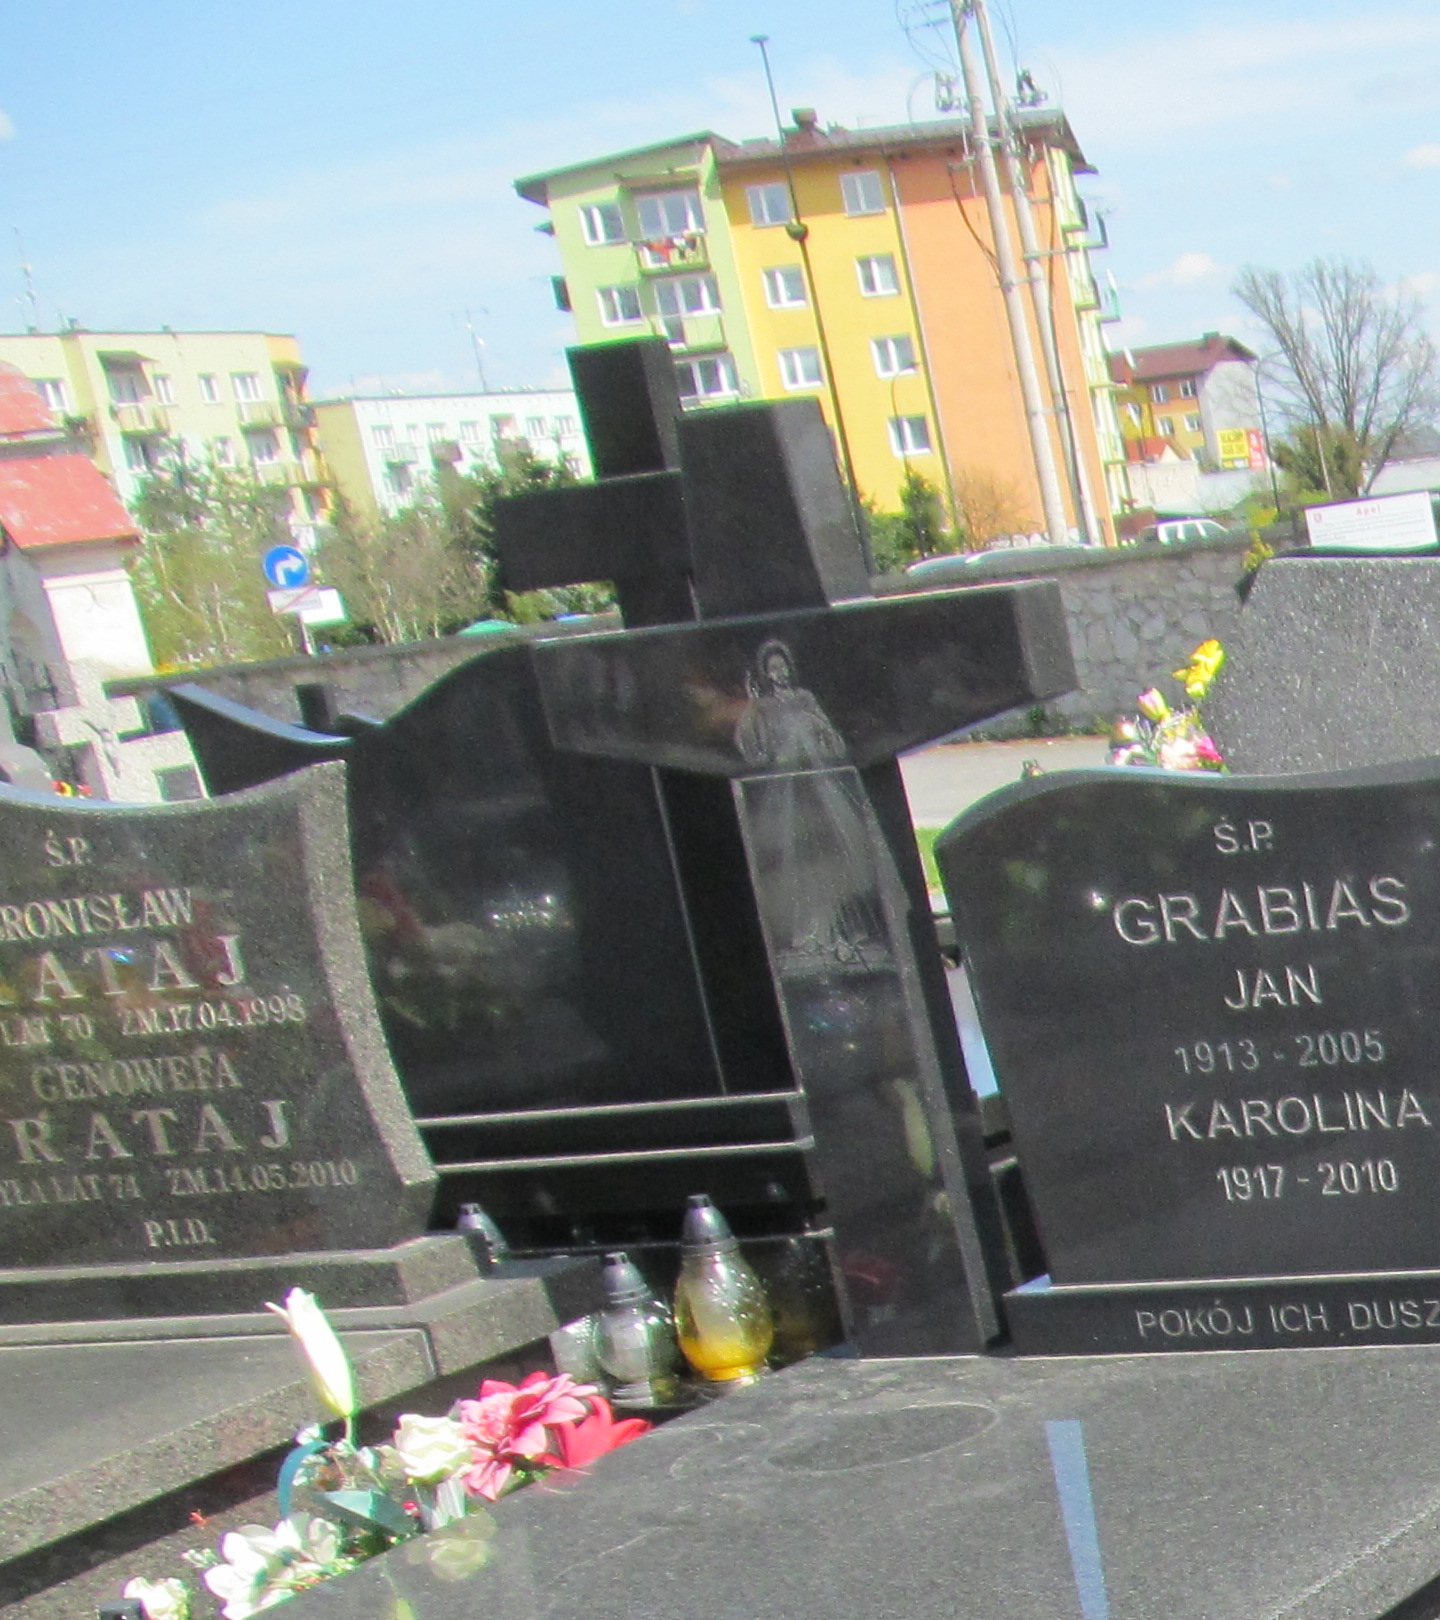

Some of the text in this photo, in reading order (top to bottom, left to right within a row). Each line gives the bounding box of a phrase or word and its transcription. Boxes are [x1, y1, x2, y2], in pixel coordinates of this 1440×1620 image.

[1356, 504, 1382, 517] Apel
[0, 887, 196, 942] RONISŁAW
[1113, 875, 1411, 946] GRABIAS
[0, 935, 245, 1004] ATAJ
[1223, 963, 1323, 1010] JAN
[1173, 1037, 1260, 1074] 1913
[1294, 1028, 1386, 1067] 2005
[31, 1052, 244, 1102] GENOWEFA
[6, 1098, 292, 1164] RATAJ
[1163, 1087, 1433, 1141] KAROLINA
[1215, 1162, 1286, 1202] 1917
[1316, 1157, 1399, 1196] 2010
[1134, 1299, 1254, 1338] POKÓJ
[1269, 1303, 1330, 1334] ICH
